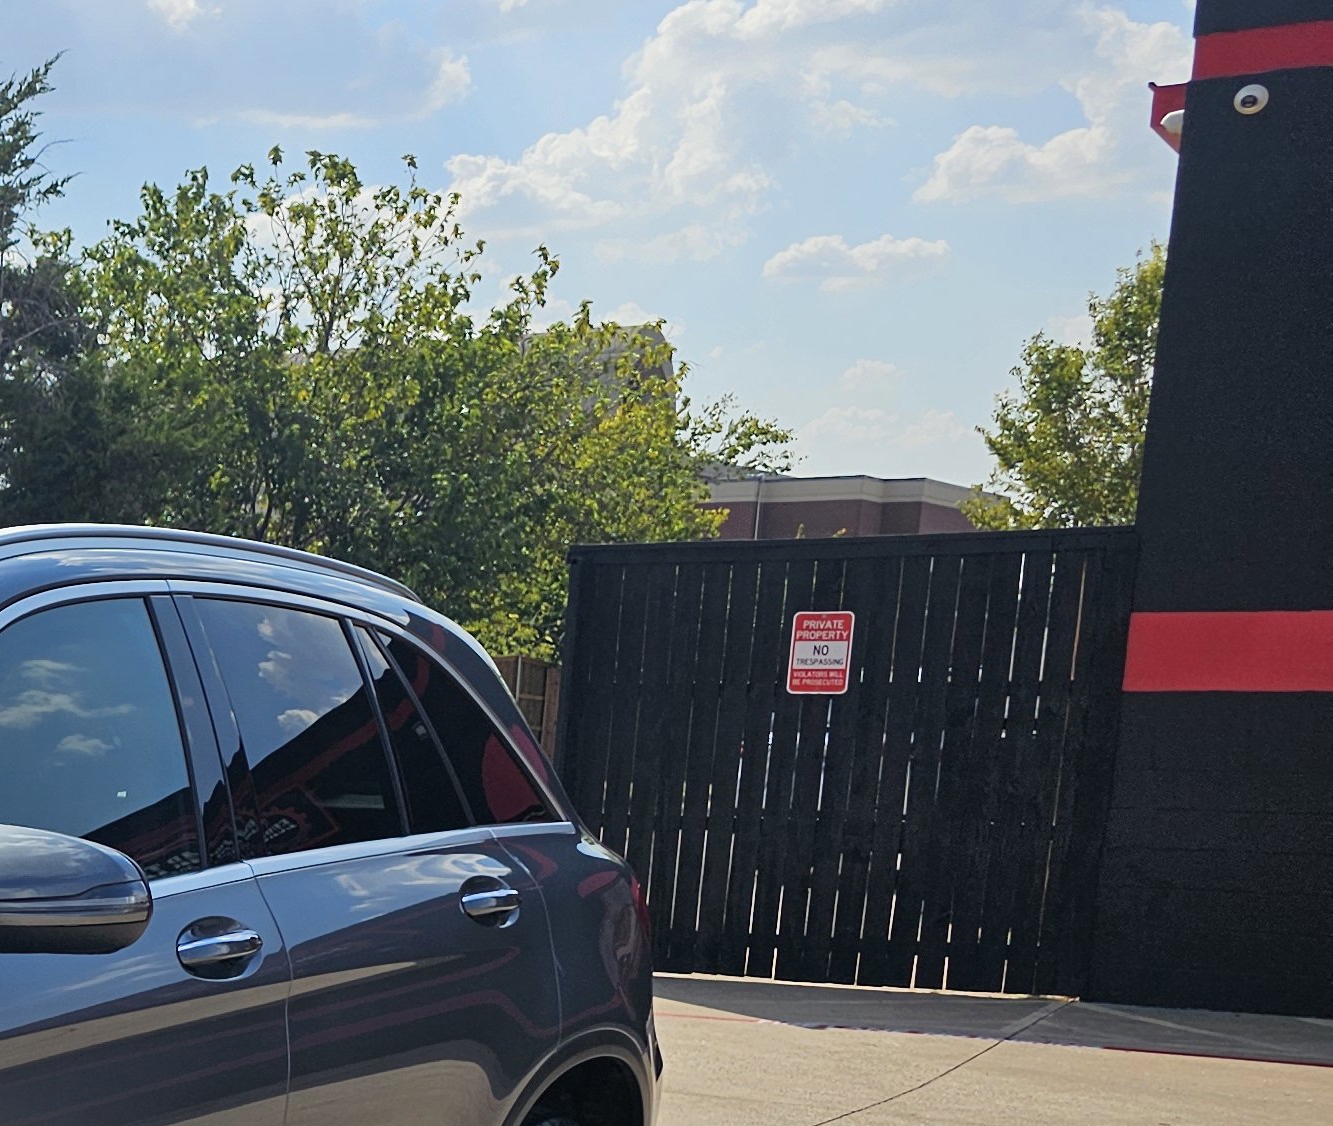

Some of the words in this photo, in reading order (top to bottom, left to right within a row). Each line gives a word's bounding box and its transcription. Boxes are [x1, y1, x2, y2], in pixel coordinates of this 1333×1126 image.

[803, 620, 844, 629] PRIVATE
[796, 630, 849, 640] PROPERTY
[813, 644, 829, 656] NO
[796, 658, 844, 666] TRESPASSING
